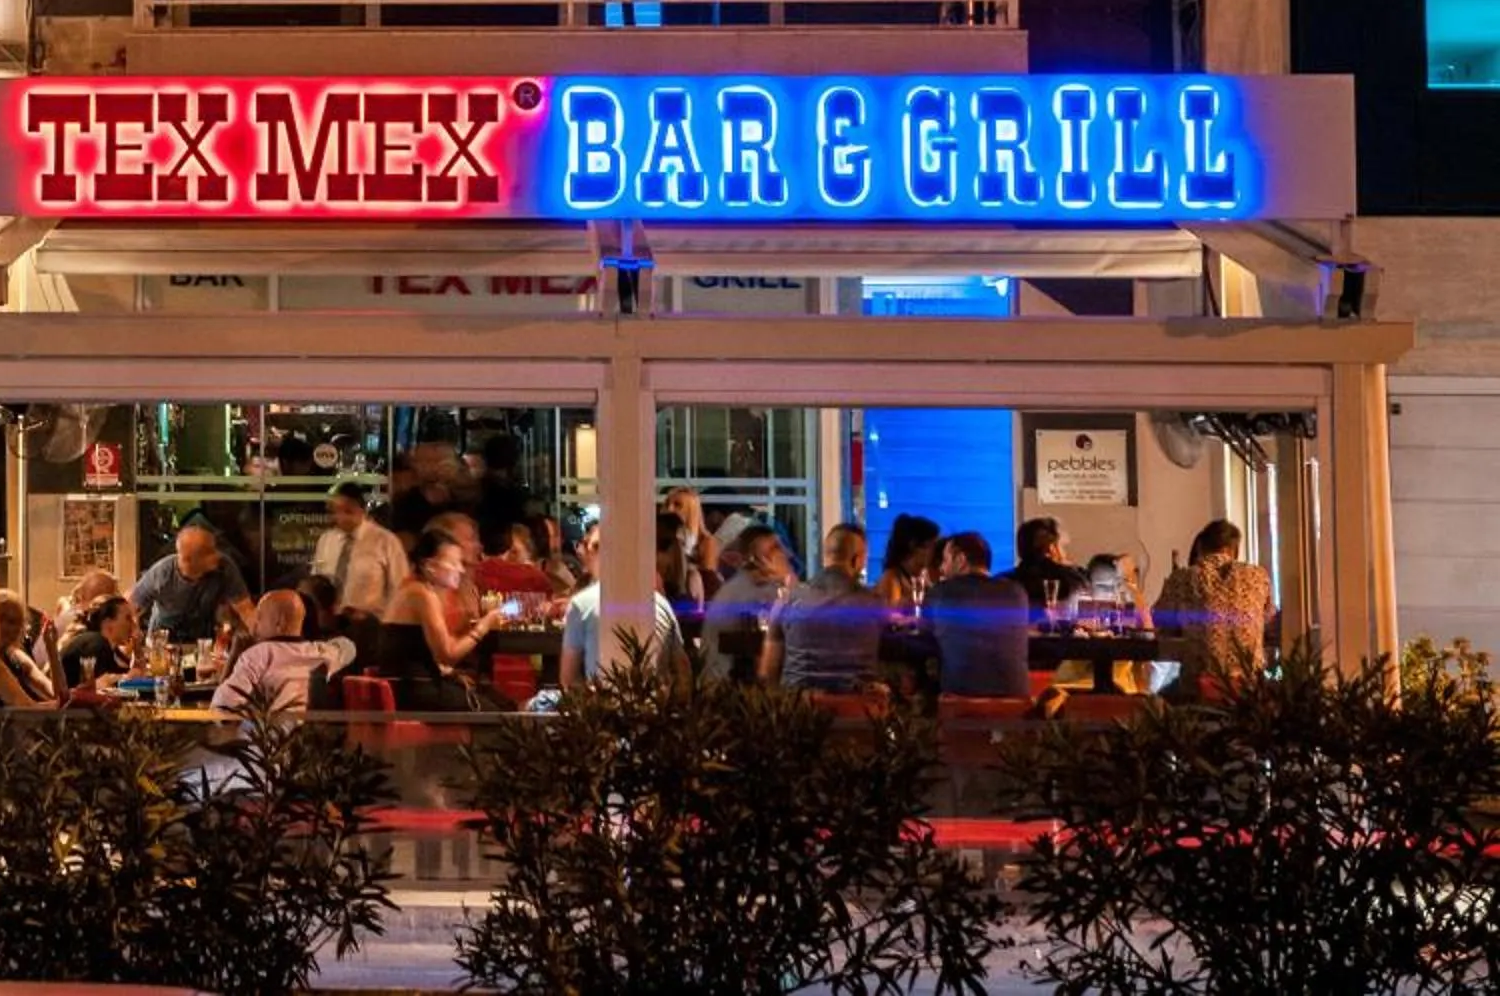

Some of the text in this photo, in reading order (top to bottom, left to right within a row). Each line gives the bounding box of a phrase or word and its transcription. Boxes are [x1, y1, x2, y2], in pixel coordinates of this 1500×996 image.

[26, 90, 230, 203] TEX
[255, 90, 500, 203] MEX
[563, 86, 787, 206] BAR
[816, 86, 871, 206] &
[903, 86, 1240, 206] GRILL
[1047, 454, 1117, 472] pebbles
